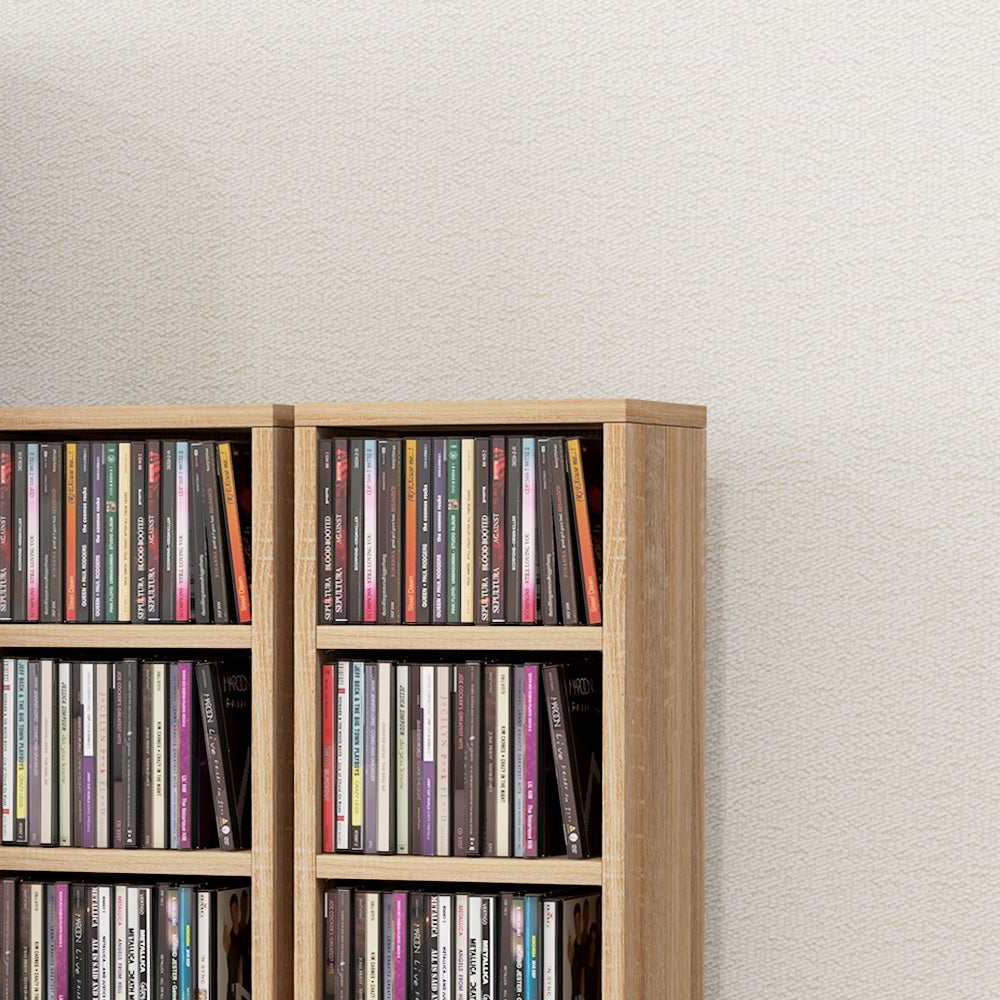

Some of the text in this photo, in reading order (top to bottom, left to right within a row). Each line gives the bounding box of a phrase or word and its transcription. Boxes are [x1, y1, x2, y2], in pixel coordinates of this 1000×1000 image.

[324, 577, 332, 620] SEPULTURA
[91, 953, 98, 961] IS
[431, 964, 438, 972] IS
